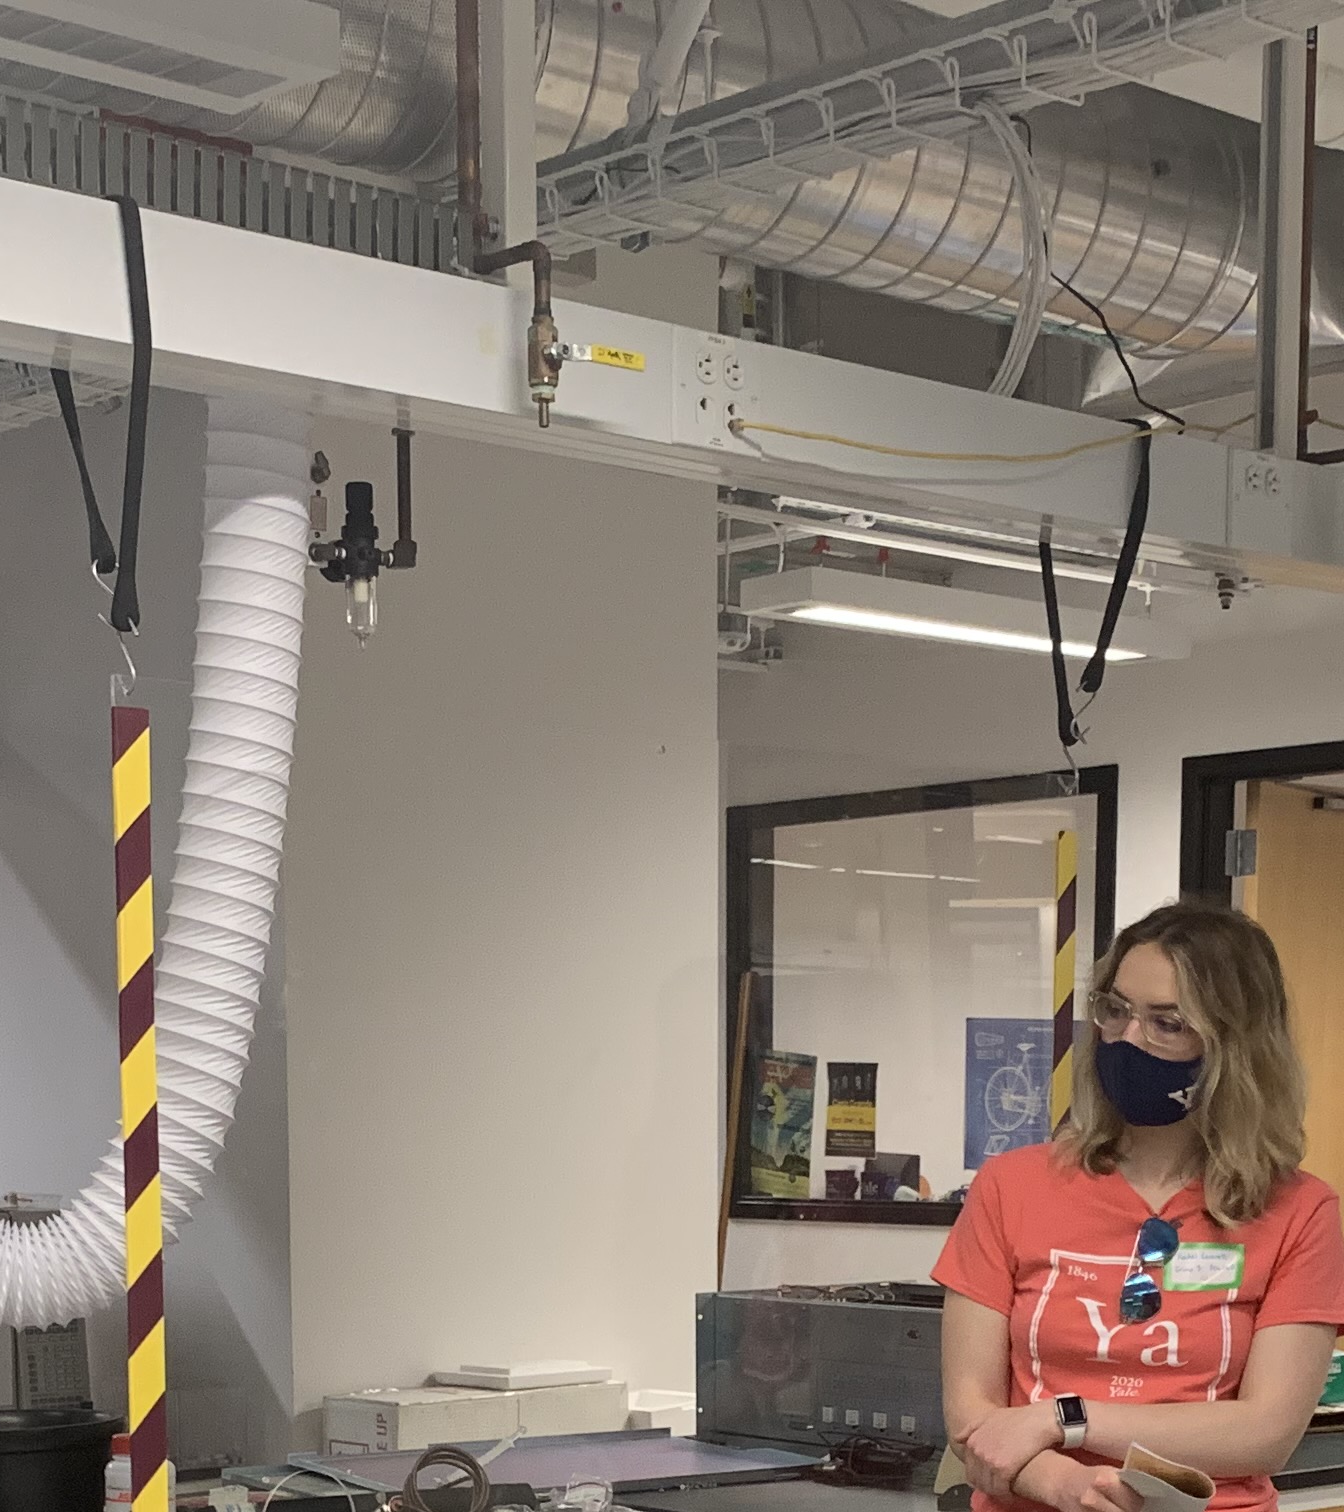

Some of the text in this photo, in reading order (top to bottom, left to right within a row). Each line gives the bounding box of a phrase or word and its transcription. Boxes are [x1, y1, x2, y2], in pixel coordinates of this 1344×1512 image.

[1067, 1264, 1098, 1282] 1846
[1076, 1295, 1189, 1368] Ya
[1110, 1375, 1144, 1388] 2020
[1109, 1385, 1140, 1398] Yale
